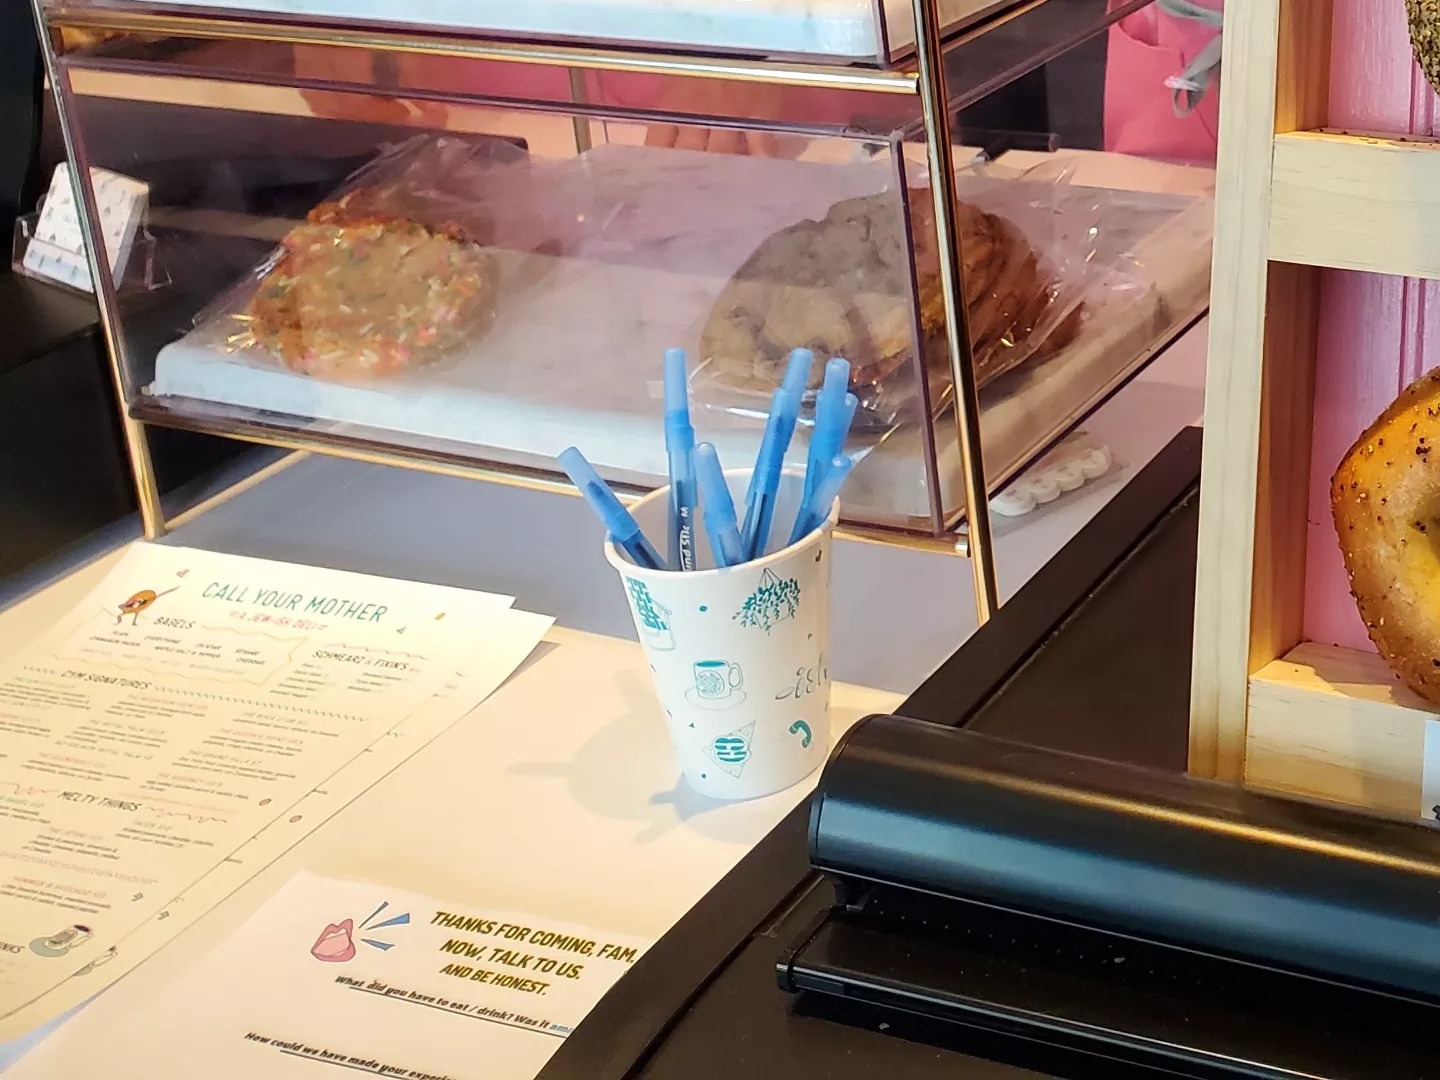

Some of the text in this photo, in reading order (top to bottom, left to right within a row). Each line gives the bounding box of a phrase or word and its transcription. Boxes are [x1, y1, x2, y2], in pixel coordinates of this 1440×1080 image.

[202, 582, 389, 623] CALL YOUR MOTHER
[430, 911, 639, 964] THANKS FOR COMING, FAM.
[439, 938, 585, 981] NOW, TALK TO US.
[439, 963, 551, 996] AND BE HONEST.
[335, 974, 364, 989] What
[366, 979, 386, 993] did
[383, 983, 408, 997] you
[407, 988, 437, 1005] have
[437, 996, 450, 1007] to
[450, 1000, 470, 1012] eat
[477, 1005, 514, 1021] drink?
[513, 1014, 538, 1026] Was
[539, 1019, 551, 1029] it
[244, 1031, 271, 1046] How
[271, 1036, 302, 1052] could
[302, 1044, 319, 1056] we
[319, 1049, 348, 1062] have
[349, 1053, 380, 1068] made
[379, 1064, 408, 1075] your
